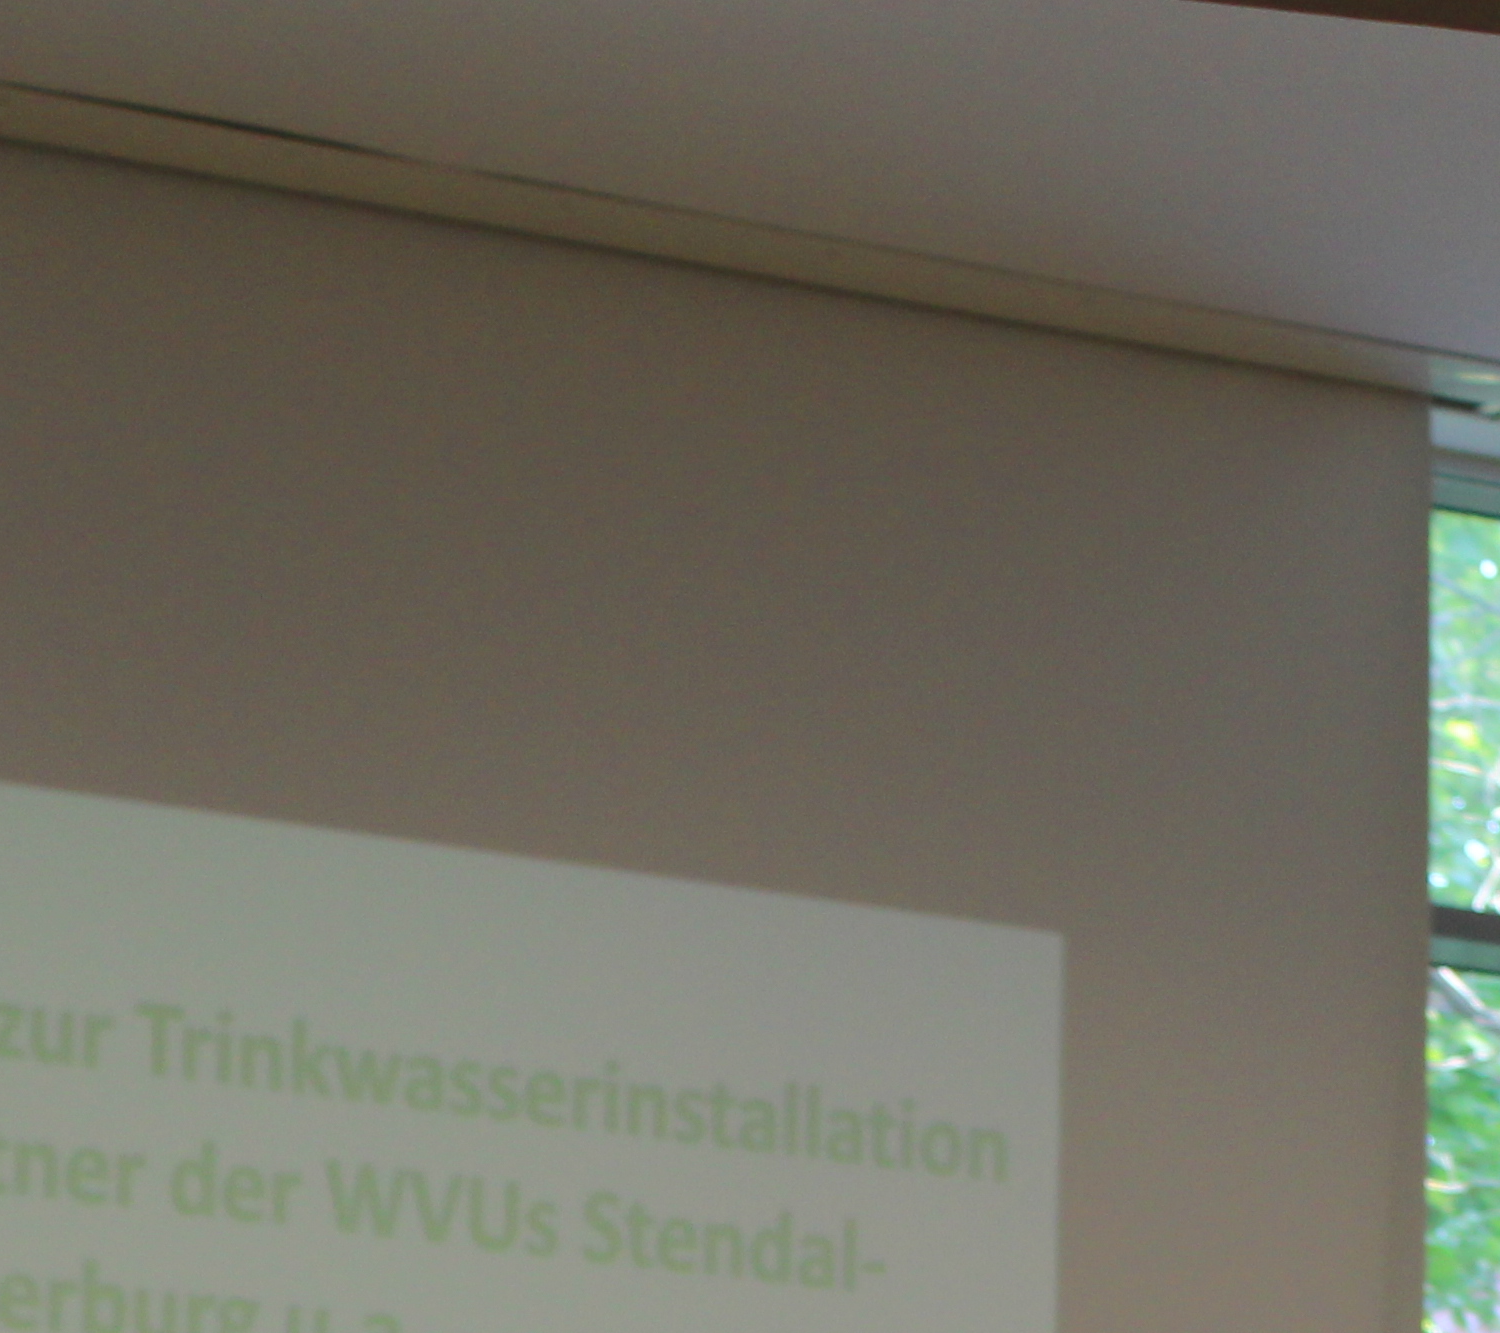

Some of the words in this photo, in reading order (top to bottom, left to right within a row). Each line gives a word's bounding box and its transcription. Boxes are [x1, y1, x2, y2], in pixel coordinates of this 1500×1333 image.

[134, 999, 1010, 1183] Trinkwasserinstallation
[169, 1139, 302, 1225] der
[325, 1157, 559, 1258] WVUs
[580, 1189, 888, 1291] Stendal-
